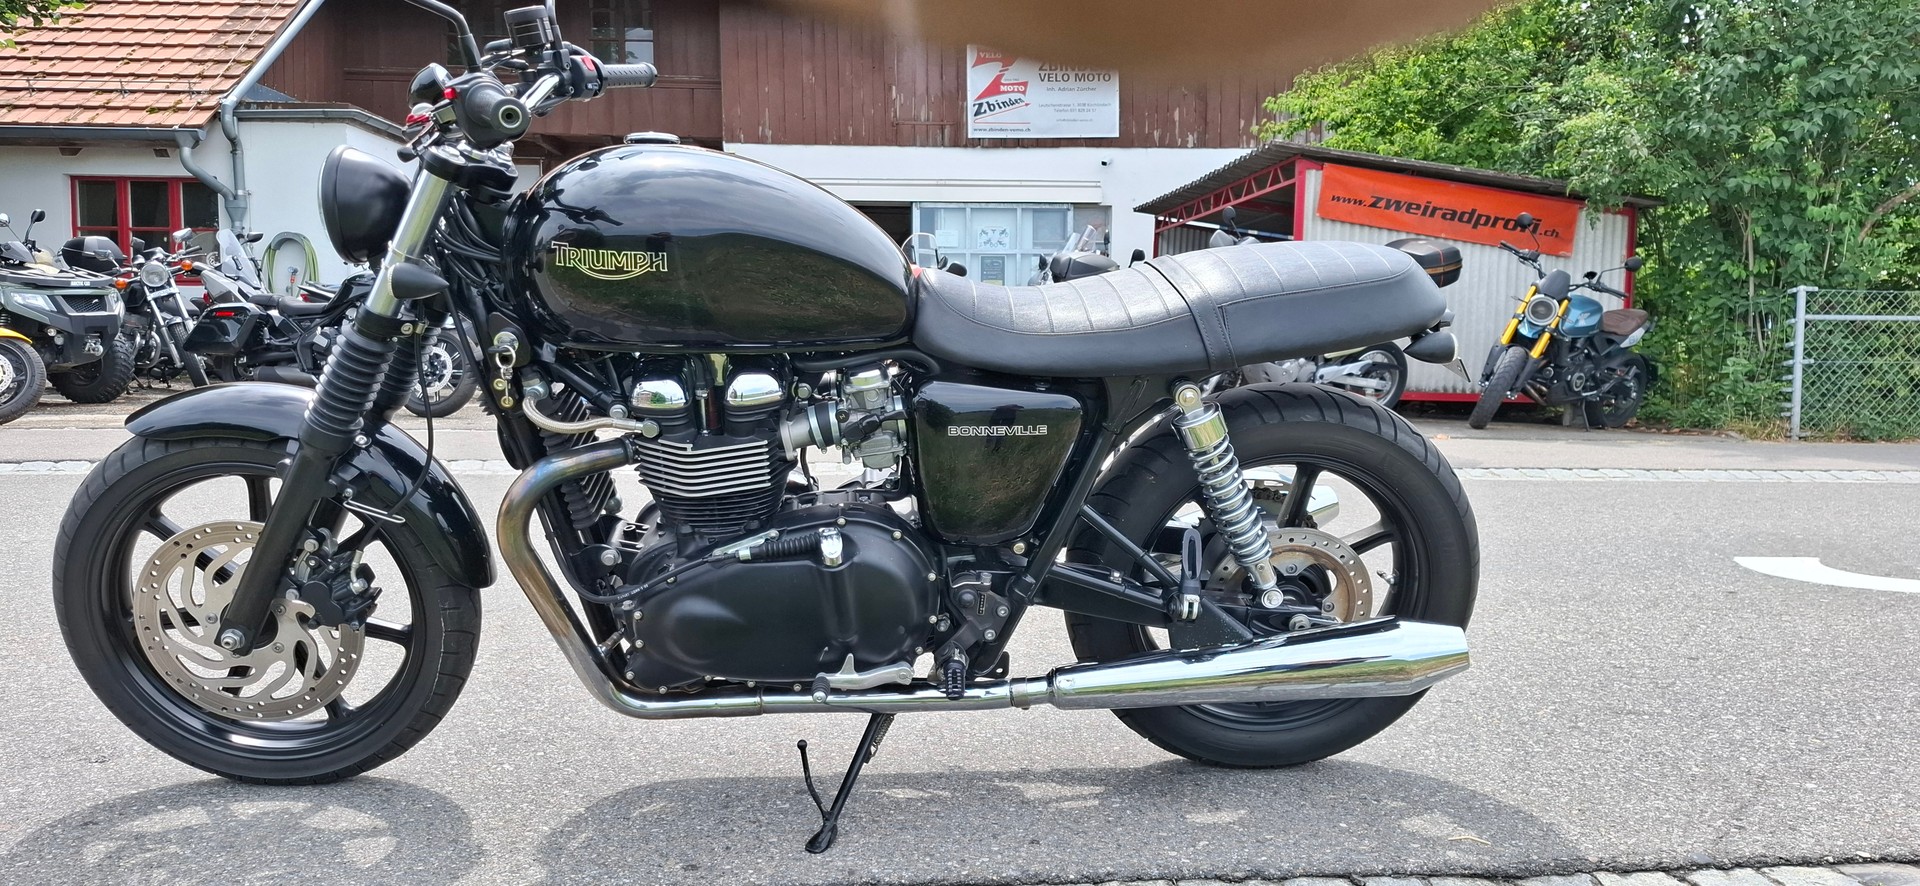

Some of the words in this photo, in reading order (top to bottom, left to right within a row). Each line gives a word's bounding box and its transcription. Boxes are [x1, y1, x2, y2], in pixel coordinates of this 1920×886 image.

[1038, 62, 1112, 72] ZBIND
[1038, 72, 1070, 83] VELO
[1074, 72, 1112, 83] MOTO
[972, 97, 1025, 117] Zbinden
[551, 241, 668, 280] TRIUMPH
[948, 425, 1047, 436] BONNEVILLE
